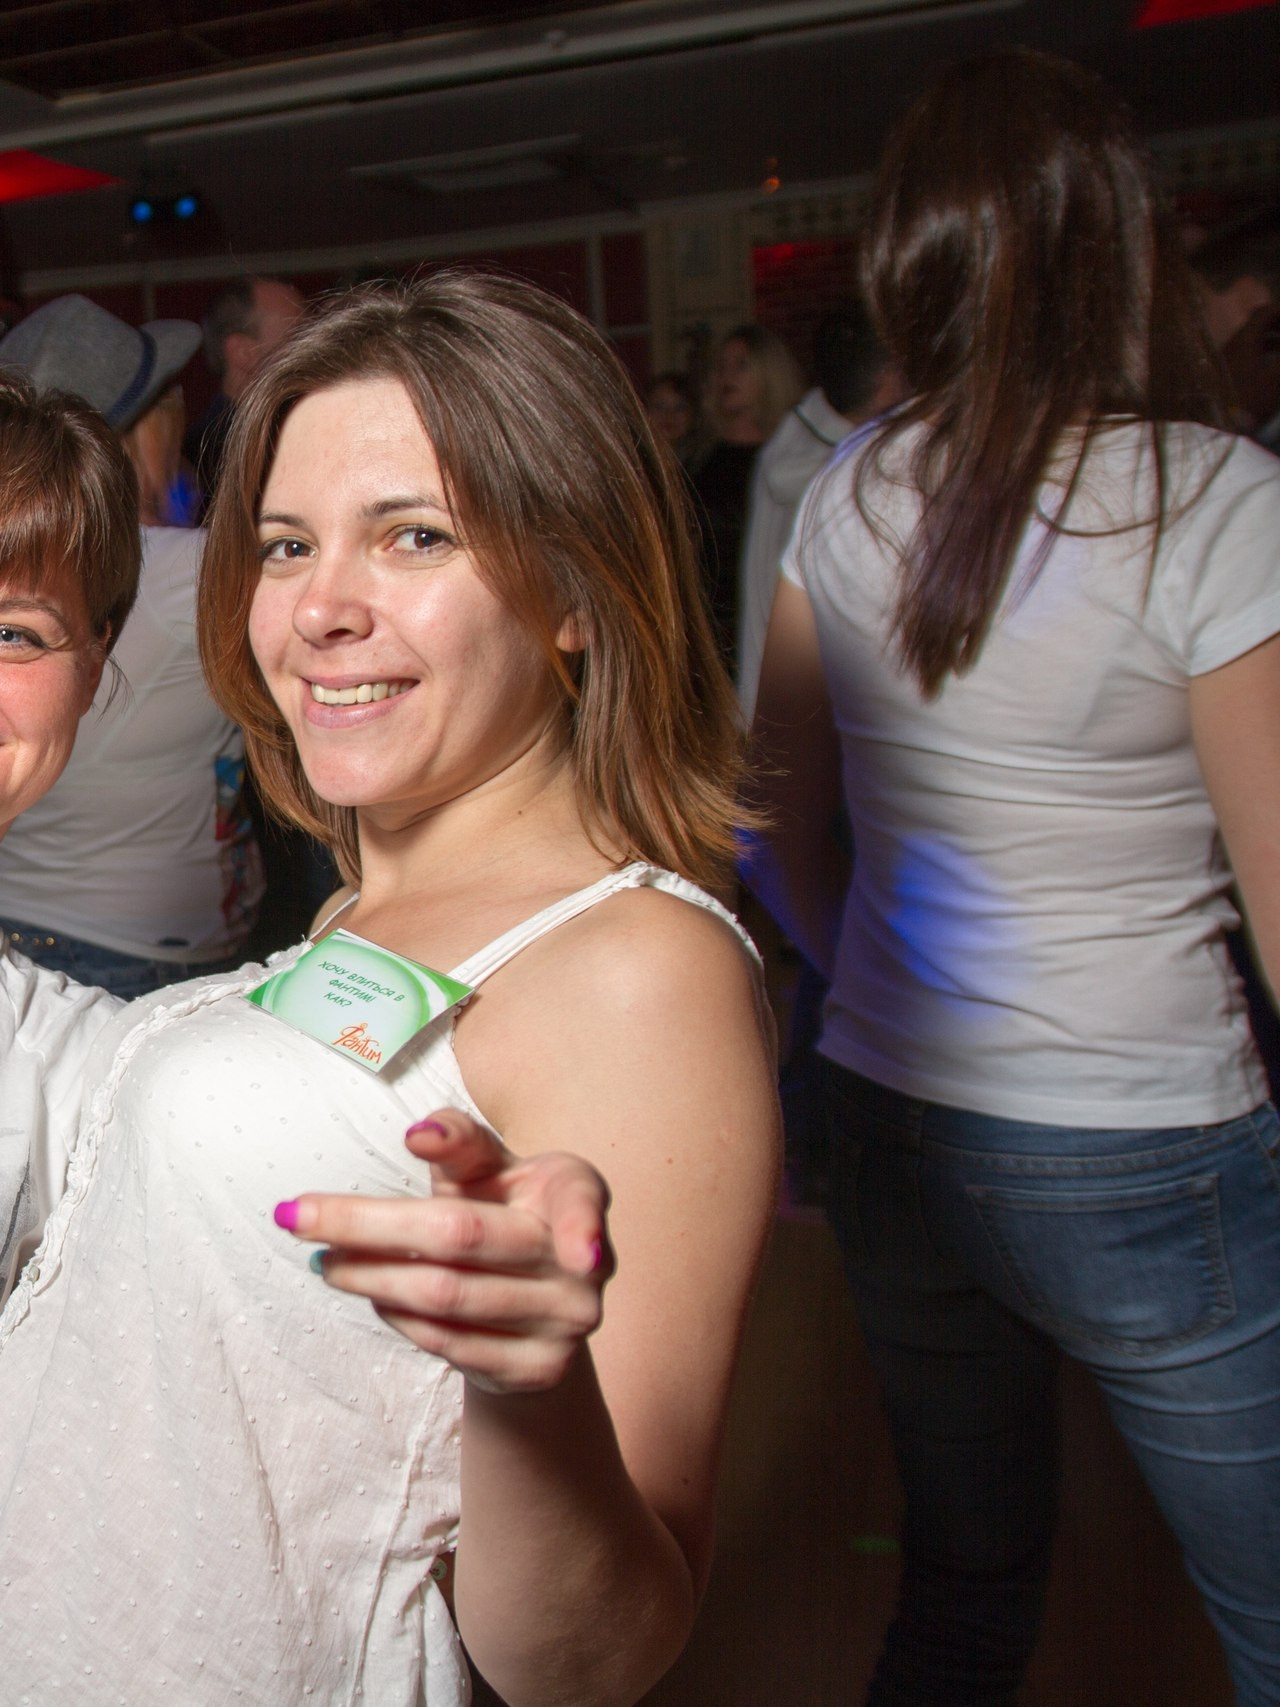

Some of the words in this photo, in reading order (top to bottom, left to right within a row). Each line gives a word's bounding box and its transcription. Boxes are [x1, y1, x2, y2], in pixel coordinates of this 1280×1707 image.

[318, 961, 349, 975] ХОЧУ
[393, 994, 406, 1002] В
[323, 991, 353, 1007] КАК?
